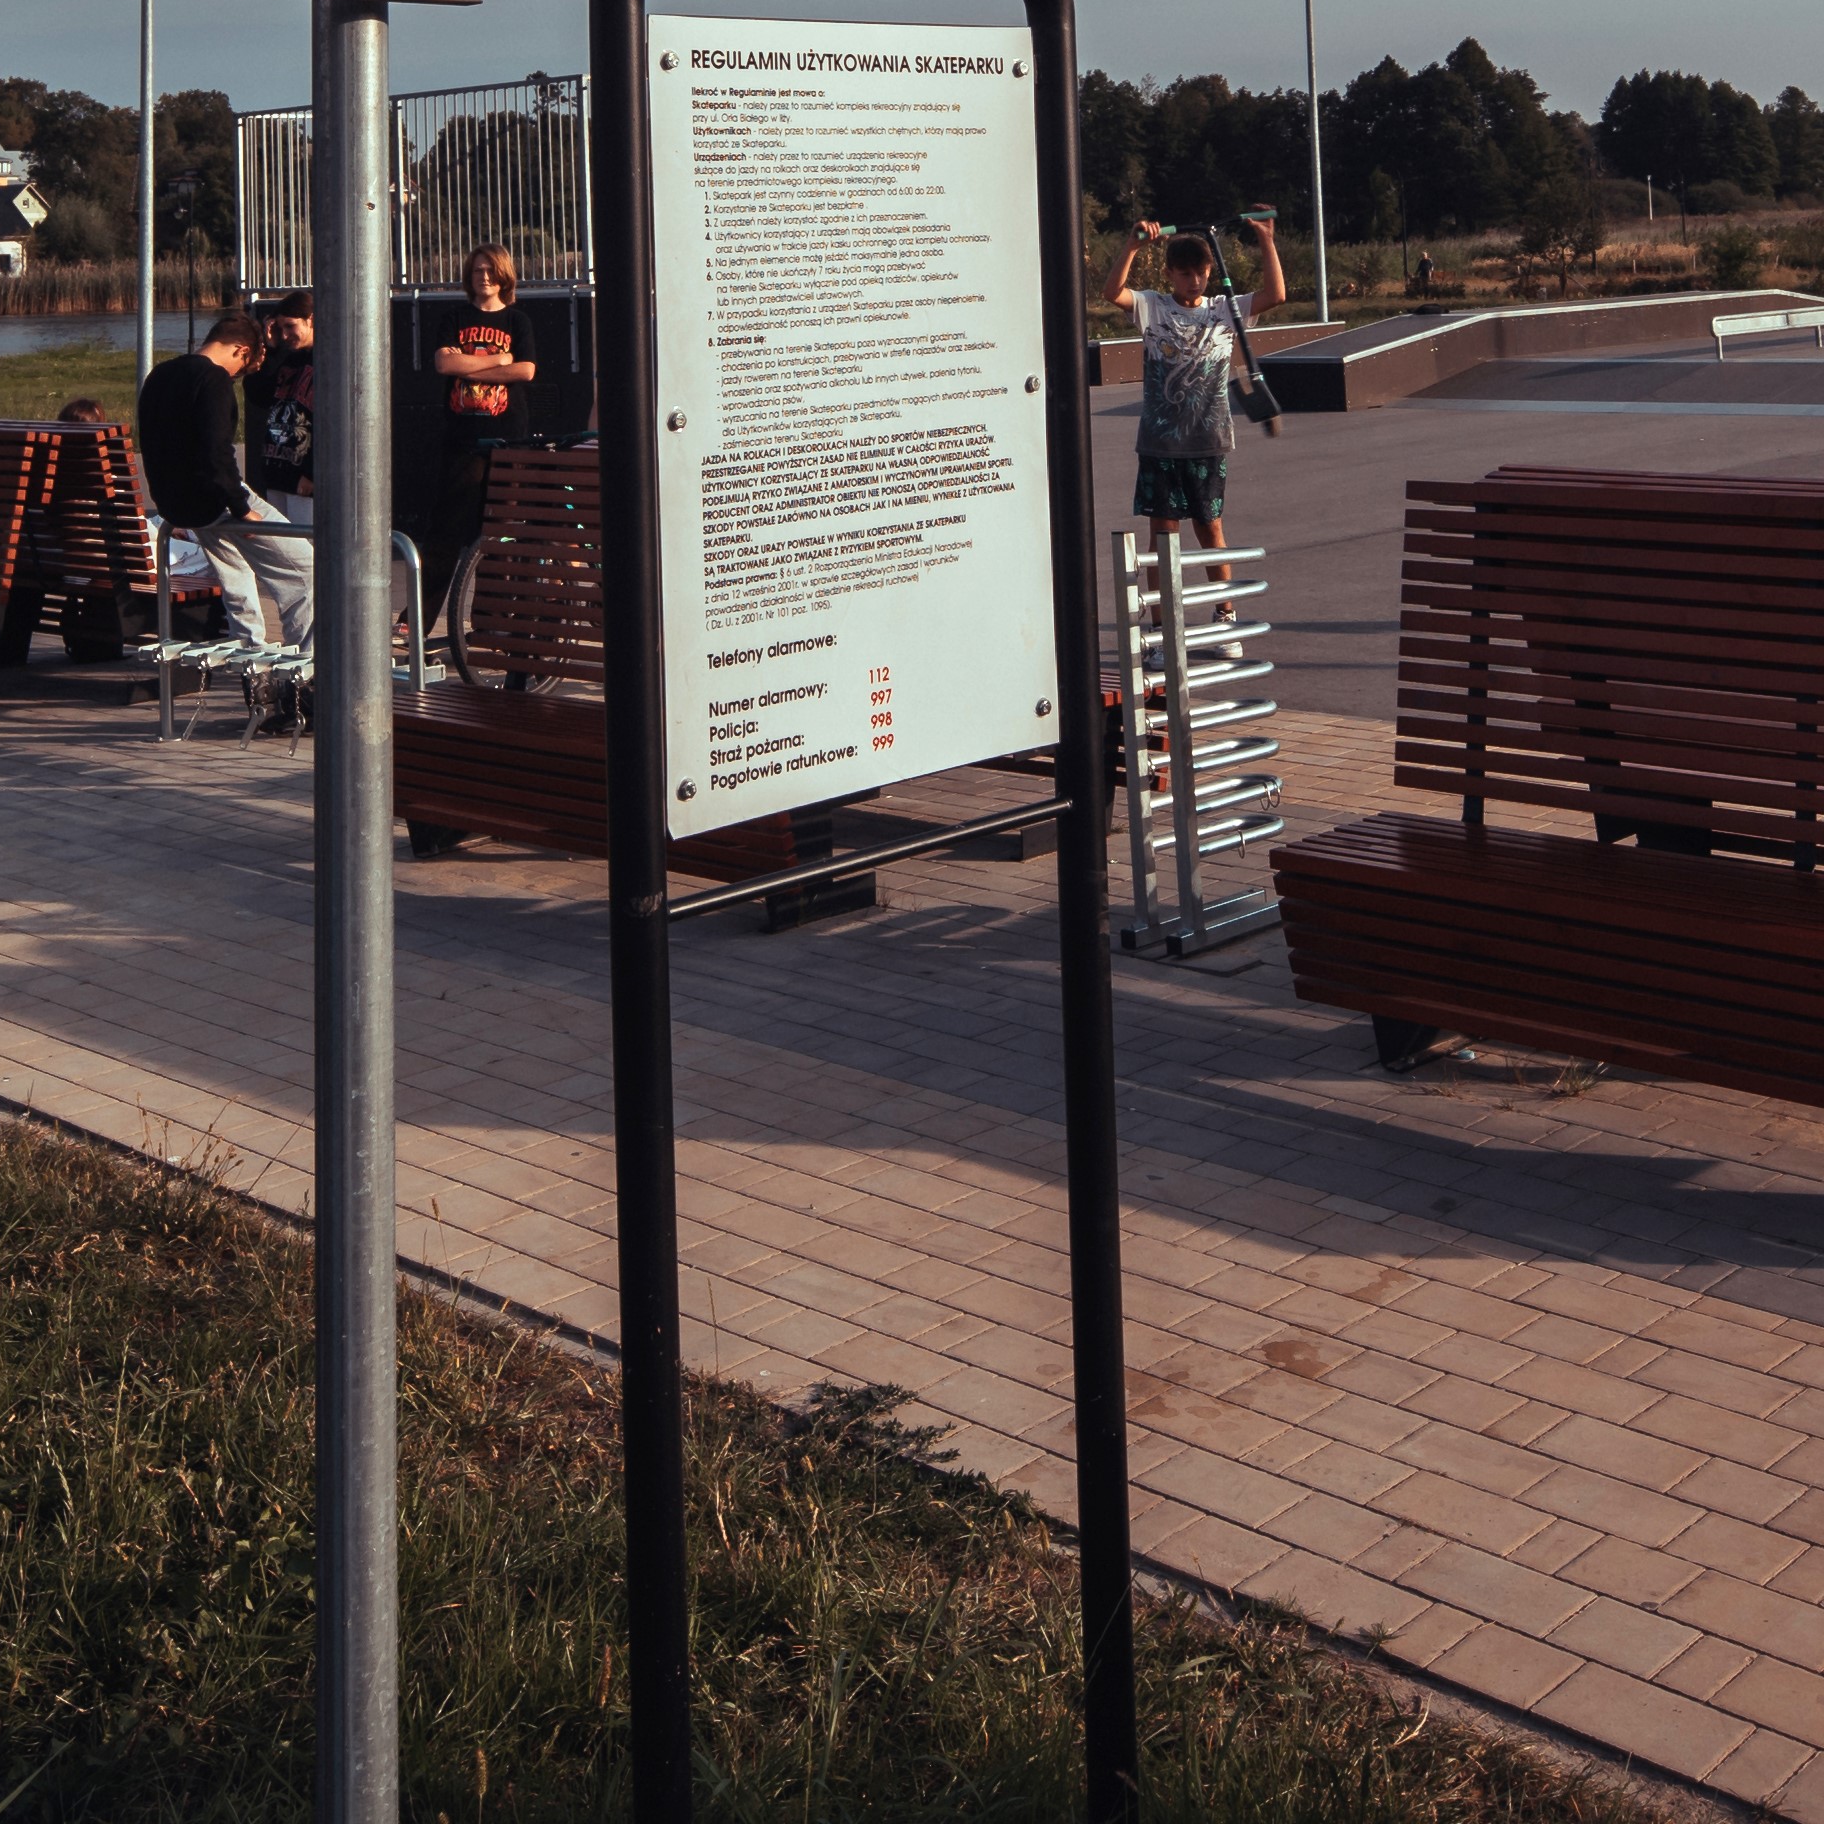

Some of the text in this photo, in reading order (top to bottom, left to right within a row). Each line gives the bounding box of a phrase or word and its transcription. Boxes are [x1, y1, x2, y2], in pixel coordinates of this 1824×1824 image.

[691, 50, 1004, 75] REGULAMIN UŻYTKOWANIA SKATEPARKU
[691, 86, 719, 97] Ilekroć
[729, 87, 777, 99] Regulaminie
[778, 88, 792, 99] jest
[792, 90, 817, 98] mowa
[458, 325, 512, 353] URIOUS
[717, 336, 752, 347] Zabrania
[753, 334, 767, 346] się:
[701, 454, 728, 467] JAZDA
[743, 448, 782, 461] ROLKACH
[787, 440, 848, 456] DESKOROLKACH
[849, 436, 877, 448] NALEŻY
[891, 430, 926, 444] SPORTÓW
[701, 463, 766, 480] PRZESTRZEGANIE
[767, 456, 819, 472] POWYŻSZYCH
[820, 453, 845, 465] ZASAD
[846, 451, 859, 462] NIE
[860, 447, 896, 461] ELIMINUJE
[905, 441, 937, 455] CAŁOŚCI
[938, 439, 965, 450] RYZYKA
[702, 477, 759, 494] UŻYTKOWNICY
[760, 470, 819, 486] KORZYSTAJĄCY
[830, 463, 874, 477] SKATEPARKU
[888, 458, 919, 469] WŁASNĄ
[920, 446, 991, 466] ODPOWIEDZIALNOŚĆ
[702, 492, 751, 508] PODEJMUJĄ
[752, 488, 783, 501] RYZYKO
[784, 482, 823, 497] ZWIĄZANE
[830, 475, 879, 490] AMATORSKIM
[884, 467, 938, 483] WYCZYNOWYM
[939, 461, 987, 476] UPRAWIANIEM
[702, 505, 751, 522] PRODUCENT
[752, 502, 774, 515] ORAZ
[775, 494, 836, 511] ADMINISTRATOR
[836, 490, 867, 503] OBIEKTU
[868, 488, 880, 498] NIE
[881, 483, 917, 497] PONOSZĄ
[917, 472, 991, 491] ODPOWIEDZIALNOŚCI
[703, 522, 735, 536] SZKODY
[736, 516, 776, 530] POWSTAŁE
[777, 510, 819, 525] ZARÓWNO
[833, 502, 871, 517] OSOBACH
[872, 500, 887, 511] JAK
[932, 489, 962, 502] WYNIKŁE
[968, 482, 1016, 497] UŻYTKOWANIA
[704, 549, 736, 563] SZKODY
[737, 545, 760, 558] ORAZ
[761, 541, 786, 555] URAZY
[787, 535, 826, 550] POWSTAŁE
[836, 529, 866, 542] WYNIKU
[866, 522, 915, 538] KORZYSTANIA
[925, 514, 967, 529] SKATEPARKU
[716, 557, 770, 575] TRAKTOWANE
[770, 554, 793, 567] JAKO
[794, 547, 833, 563] ZWIĄZANE
[840, 541, 876, 556] RYZYKIEM
[707, 634, 838, 670] Telefony alarmowe:
[709, 666, 890, 719] Numer alarmowy: 112
[710, 688, 892, 743] Policja: 997
[710, 711, 893, 767] Straż pożarna: 998
[711, 733, 894, 791] Pogotowie ratunkowe: 999
